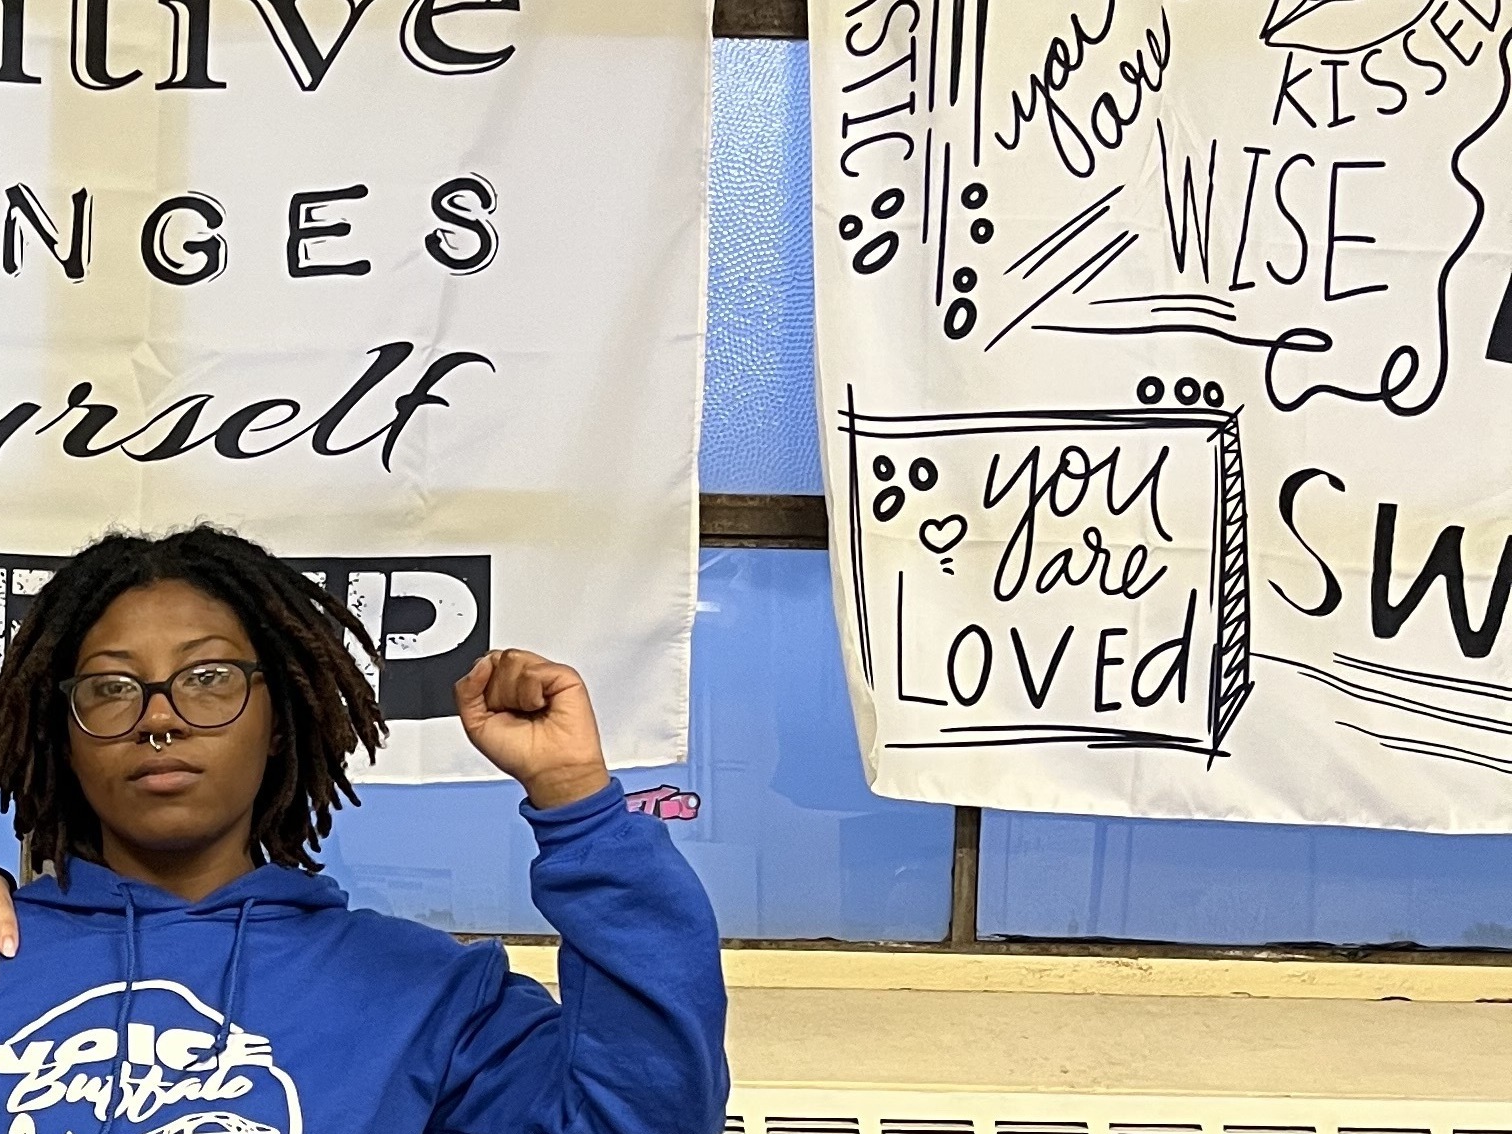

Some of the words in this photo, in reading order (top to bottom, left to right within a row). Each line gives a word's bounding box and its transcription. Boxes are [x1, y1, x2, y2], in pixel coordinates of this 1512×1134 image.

[840, 0, 921, 178] STIC
[1091, 5, 1171, 150] are
[1157, 117, 1390, 302] WISE
[983, 445, 1173, 602] you
[1035, 526, 1168, 600] are
[6, 1060, 254, 1124] Buffalo
